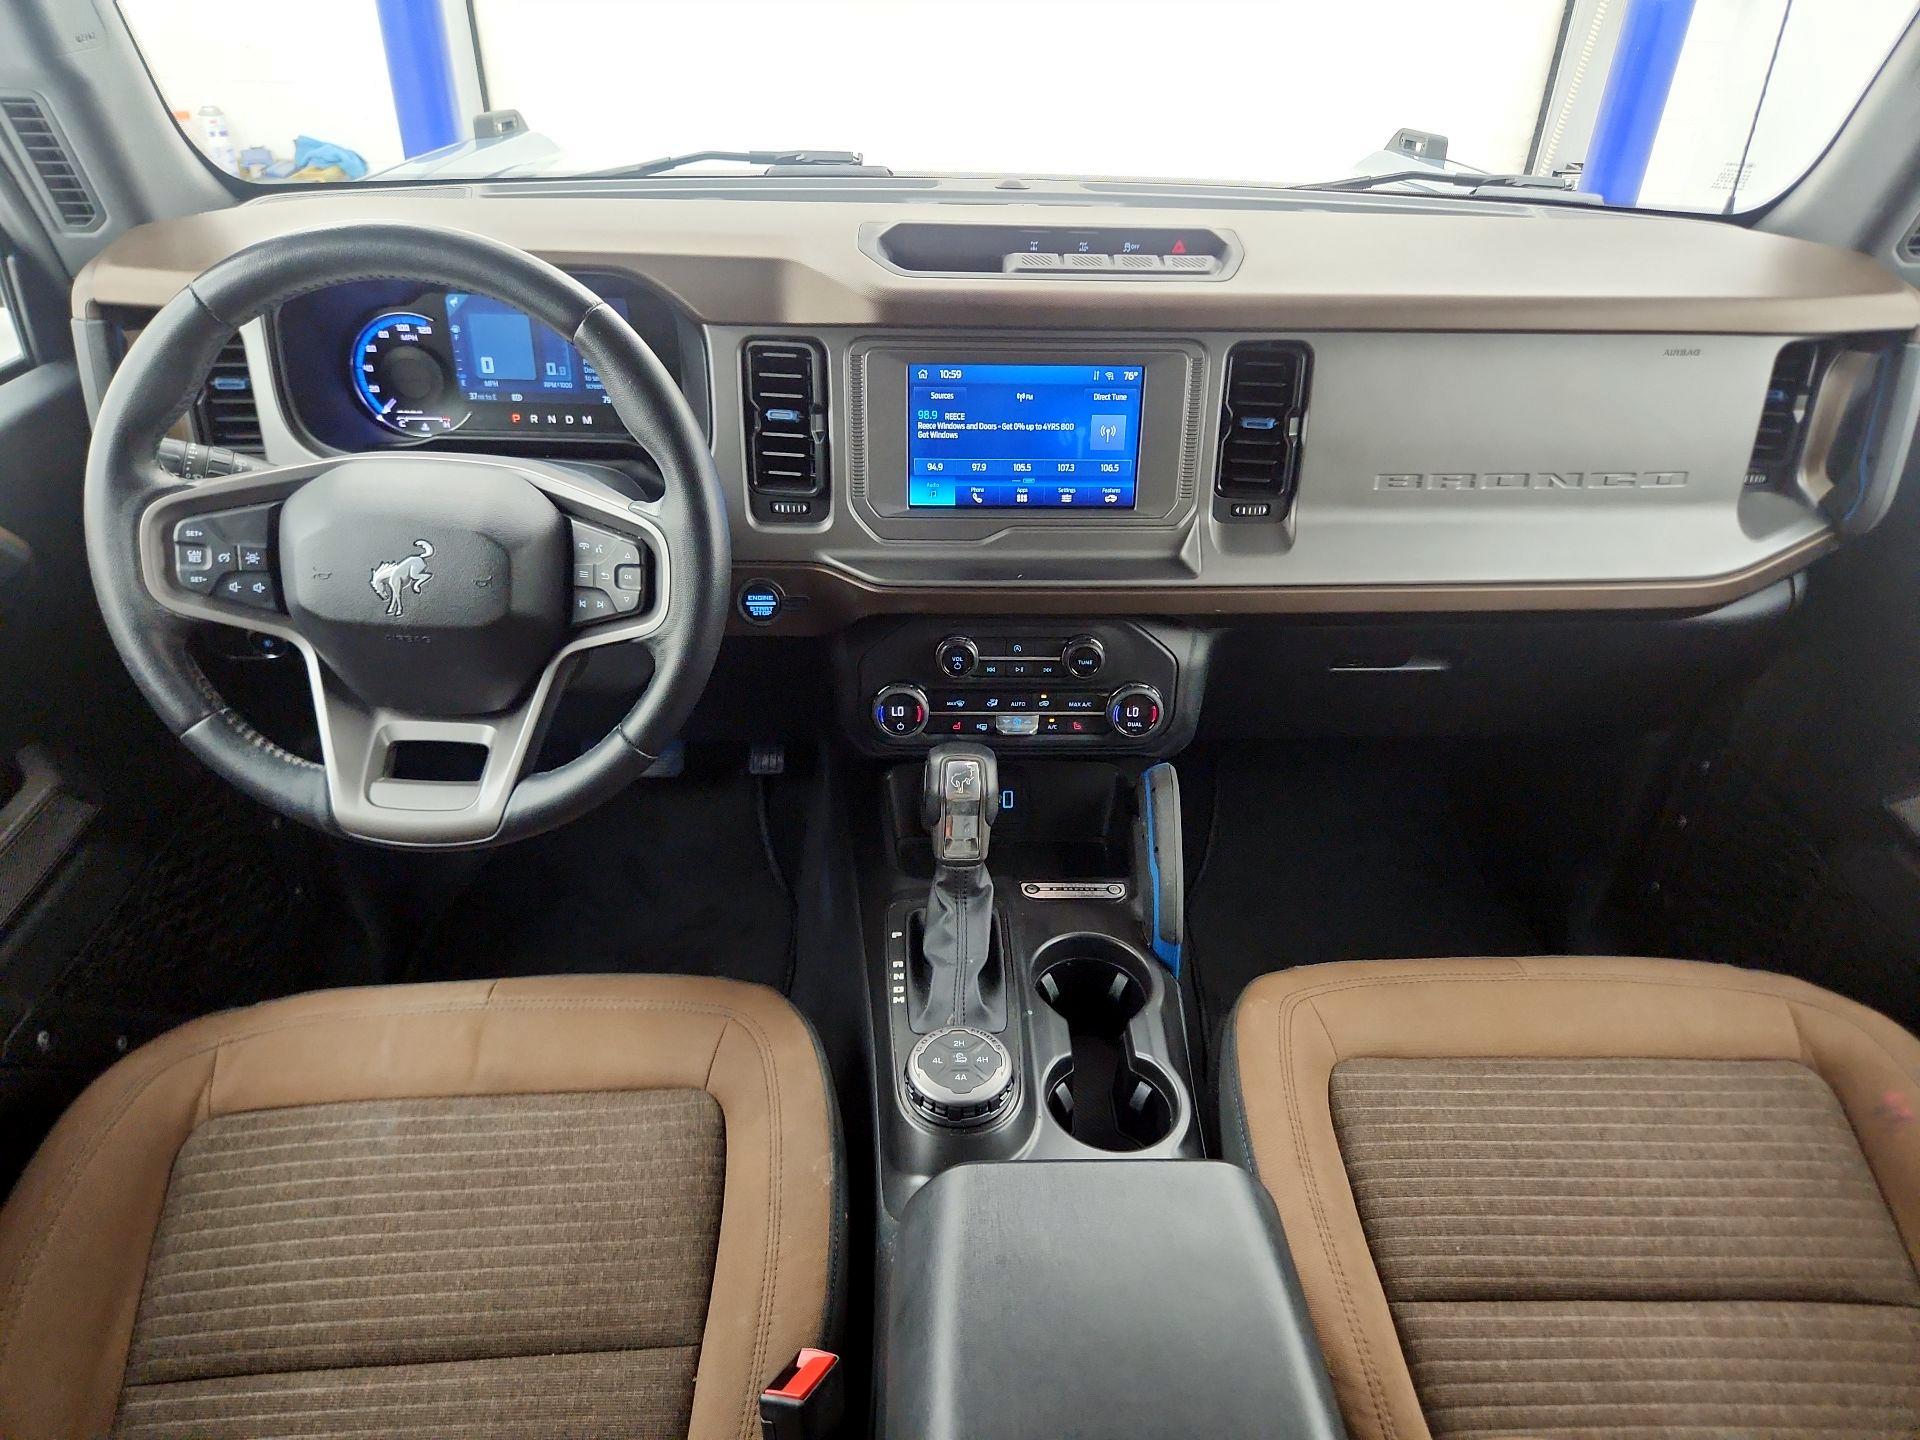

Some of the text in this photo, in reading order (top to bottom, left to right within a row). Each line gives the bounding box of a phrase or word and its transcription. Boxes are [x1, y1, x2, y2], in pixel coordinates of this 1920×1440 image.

[481, 356, 494, 373] 0
[940, 370, 962, 379] 10:59
[930, 392, 954, 400] Sources
[512, 414, 592, 424] P R N D M
[917, 410, 938, 419] 98.9
[927, 463, 943, 471] 94.9
[1101, 464, 1119, 472] 106.5
[1372, 471, 1690, 490] BRONCO
[891, 706, 904, 717] LO
[1127, 706, 1139, 717] LO
[971, 1029, 1002, 1050] MODES
